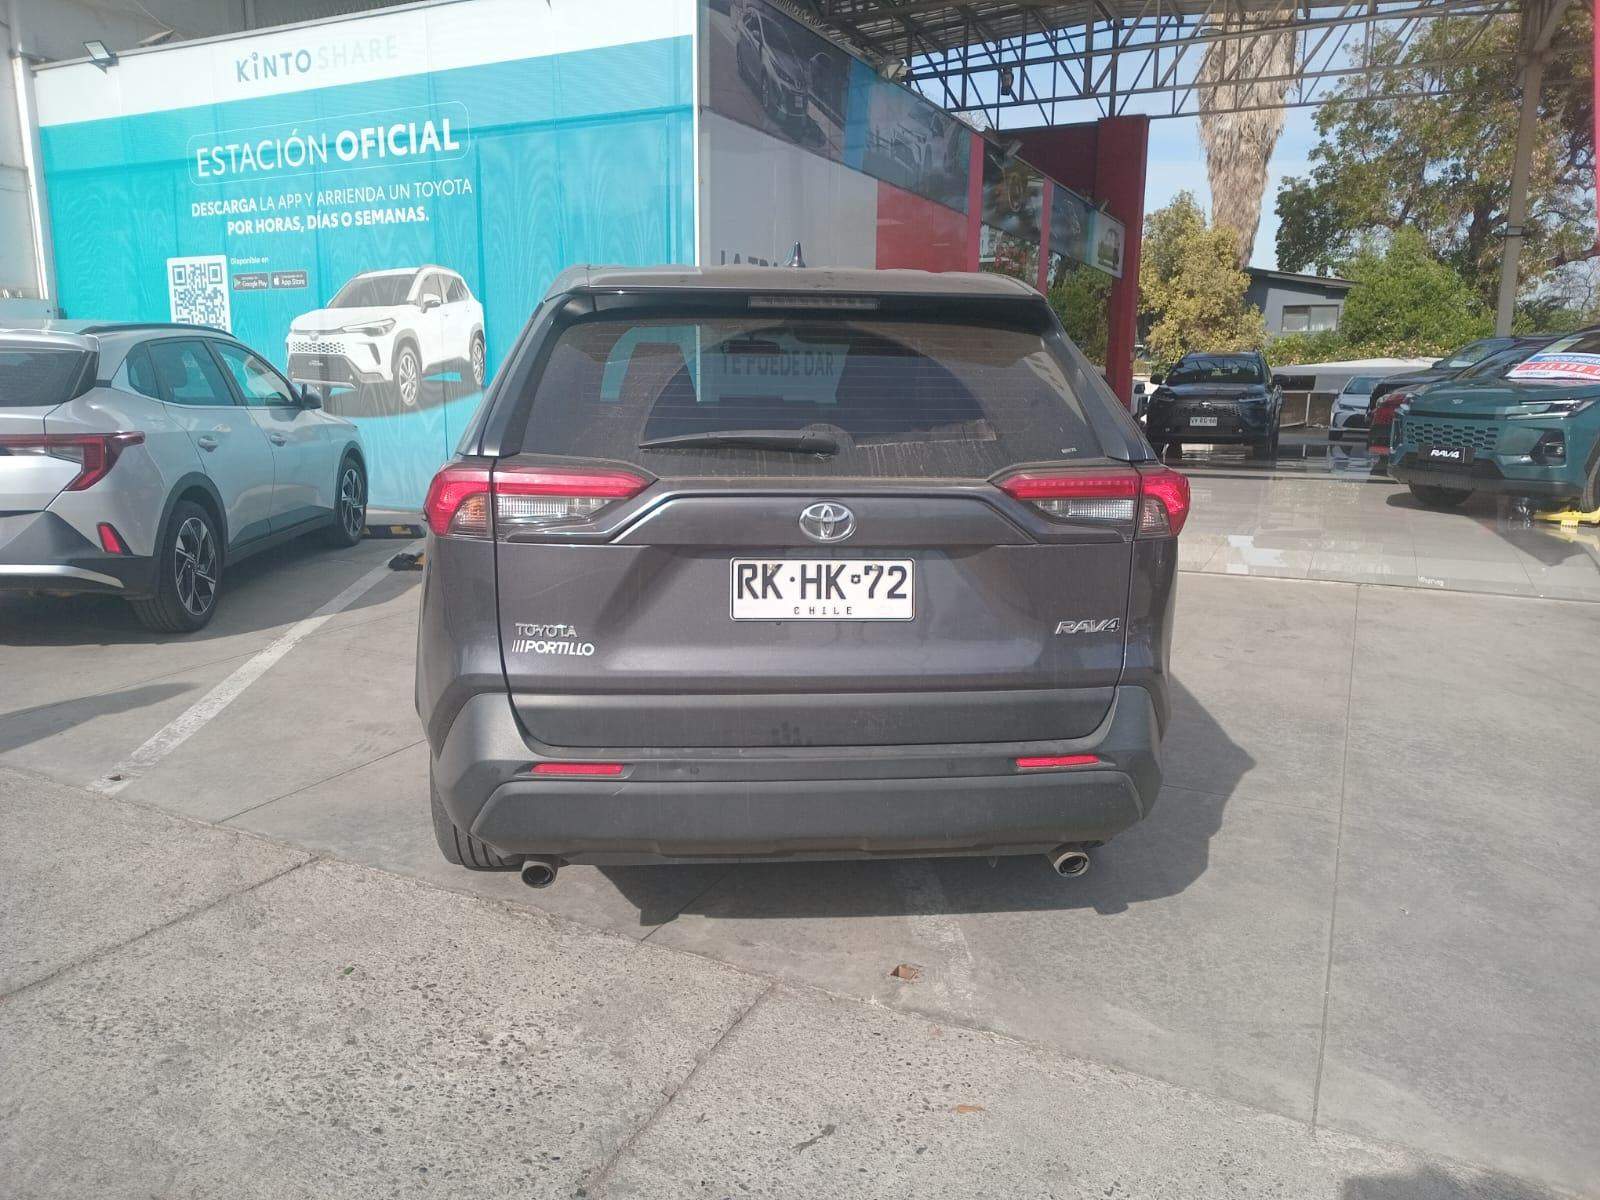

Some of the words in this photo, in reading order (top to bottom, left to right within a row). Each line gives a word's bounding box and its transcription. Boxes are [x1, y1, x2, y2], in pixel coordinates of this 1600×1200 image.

[317, 35, 398, 71] SHARE
[196, 128, 328, 177] ESTACIÓN
[335, 118, 460, 162] OFICIAL
[191, 198, 257, 217] DESCARGA
[260, 196, 275, 211] LA
[278, 193, 302, 209] APP
[304, 192, 313, 206] Y
[316, 185, 386, 206] ARRIENDA
[389, 183, 410, 200] UN
[414, 178, 473, 198] TOYOTA
[227, 220, 253, 236] POR
[255, 215, 305, 233] HORAS,
[306, 209, 339, 230] DÍAS
[340, 211, 352, 227] O
[354, 205, 430, 226] SEMANAS.
[803, 350, 834, 377] DAR
[1430, 449, 1460, 459] RAV4
[793, 606, 853, 615] CHILE
[514, 622, 578, 638] TOYOTA
[1055, 617, 1121, 635] RAV4
